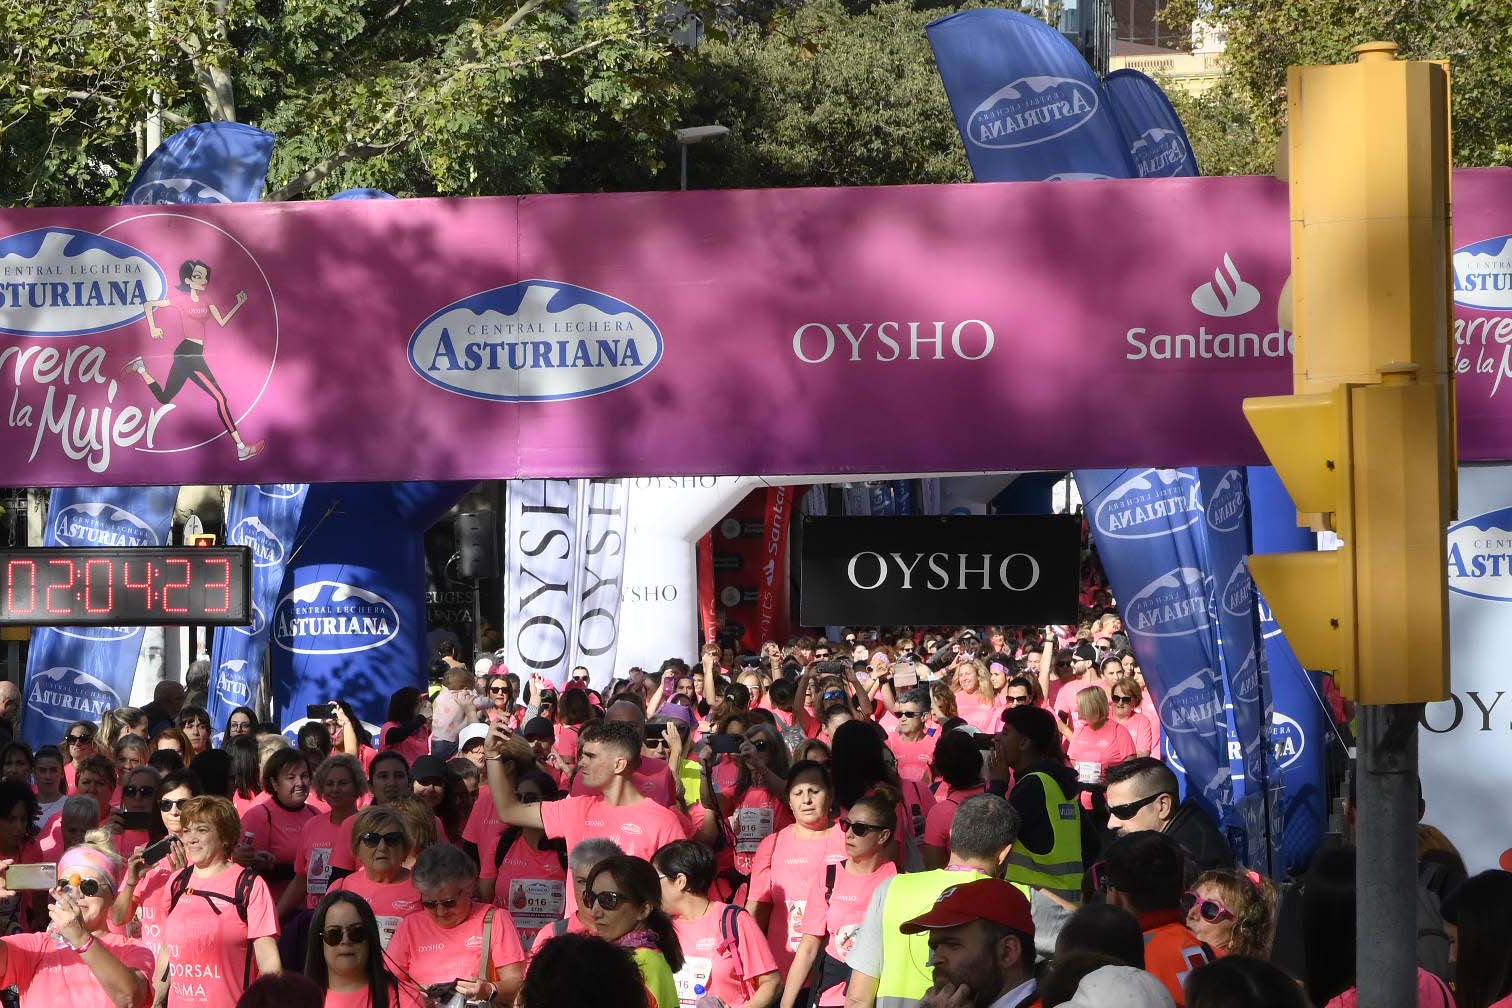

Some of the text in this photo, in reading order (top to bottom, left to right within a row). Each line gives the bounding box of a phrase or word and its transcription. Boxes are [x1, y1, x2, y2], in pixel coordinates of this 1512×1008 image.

[70, 263, 142, 275] LECHERA
[467, 320, 634, 336] CENTRAL LECHERA
[792, 319, 995, 363] OYSHO
[428, 326, 643, 371] ASTURIANA
[1127, 326, 1294, 360] Santand
[1476, 346, 1495, 373] la
[9, 388, 33, 428] la
[28, 379, 177, 473] Mujer
[636, 476, 717, 489] OYSHO
[847, 551, 1040, 592] OYSHO
[7, 558, 231, 614] 02:04:23
[278, 610, 390, 638] ASTURIANA
[336, 606, 385, 615] LECHERA
[1419, 691, 1512, 733] OY
[528, 898, 547, 906] 016
[169, 963, 221, 979] DORSAL
[678, 980, 689, 989] 16
